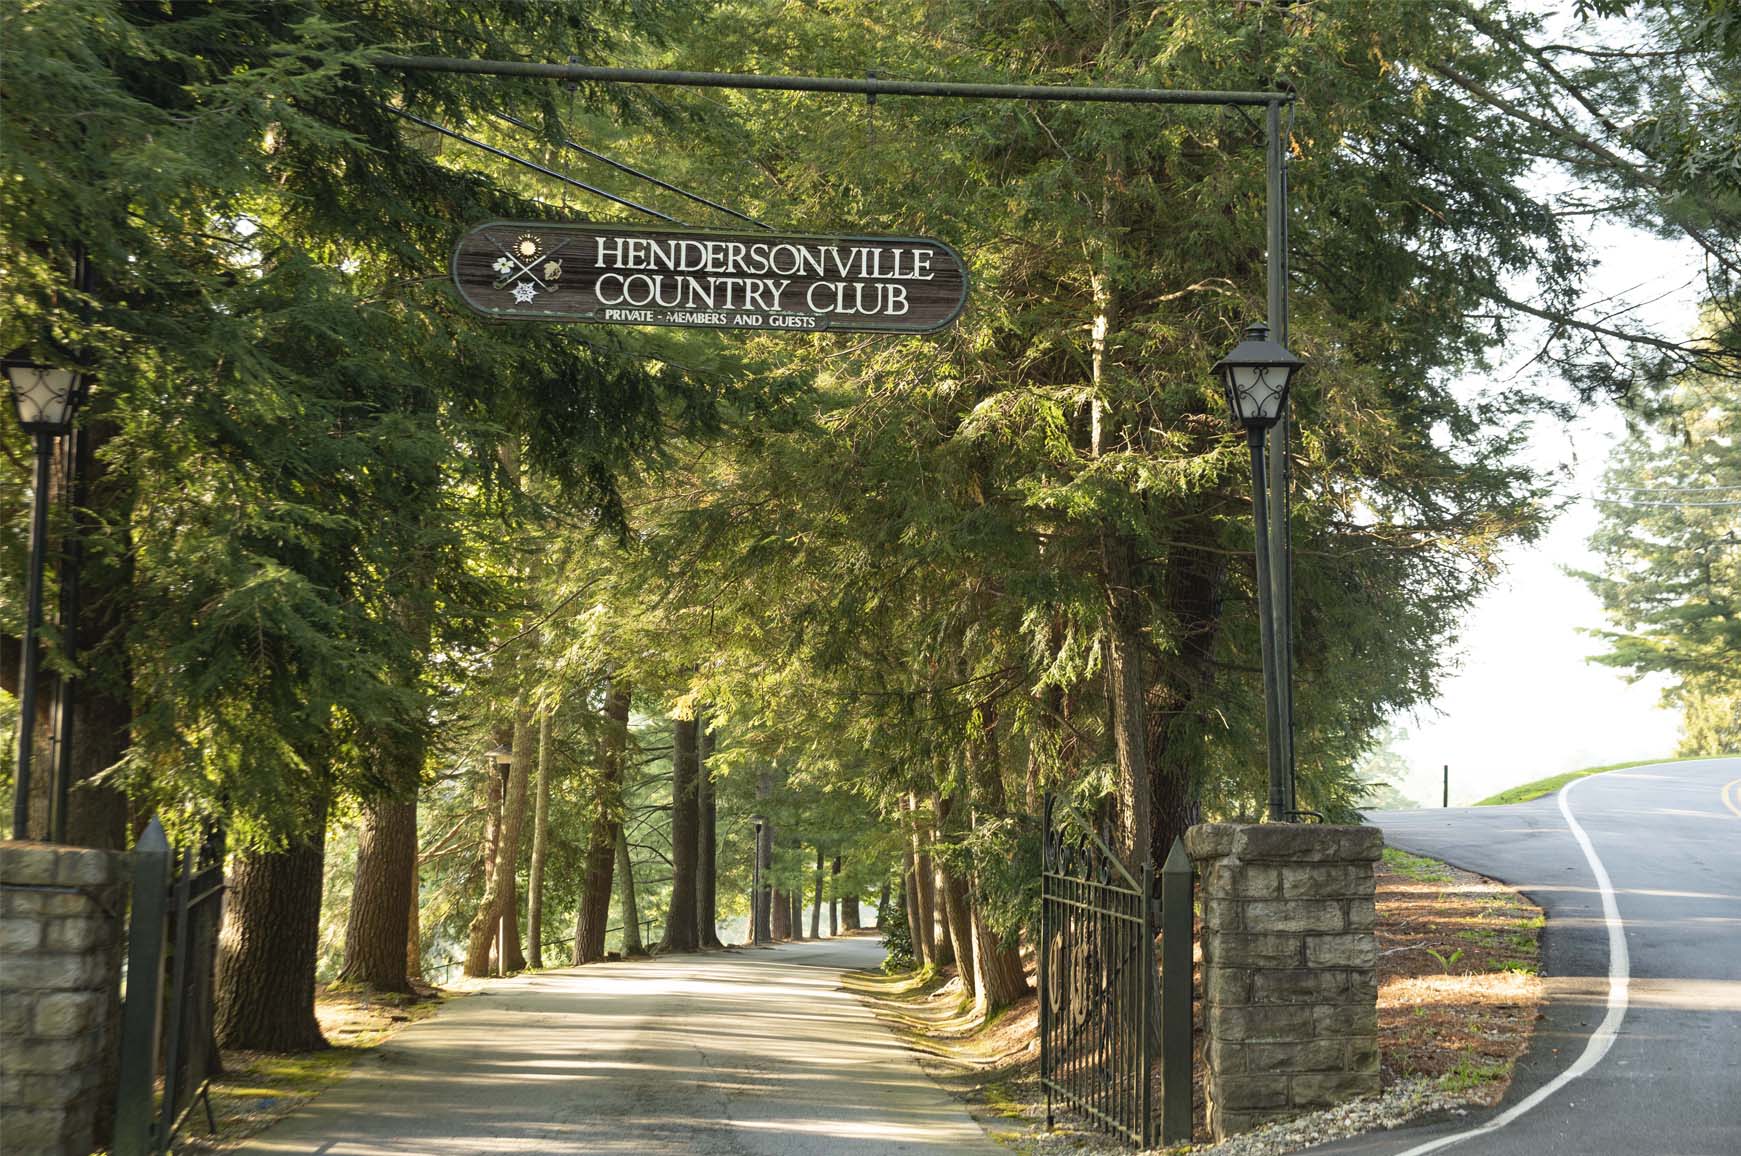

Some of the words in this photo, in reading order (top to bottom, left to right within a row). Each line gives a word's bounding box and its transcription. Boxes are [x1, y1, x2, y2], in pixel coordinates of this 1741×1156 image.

[594, 237, 935, 281] HENDERSONVILLE
[594, 273, 791, 312] COUNTRY
[806, 281, 909, 315] CLUB
[605, 309, 654, 322] PRIVATE
[665, 311, 727, 325] MEMBERS
[733, 314, 763, 326] AND
[769, 315, 816, 328] GUESTS
